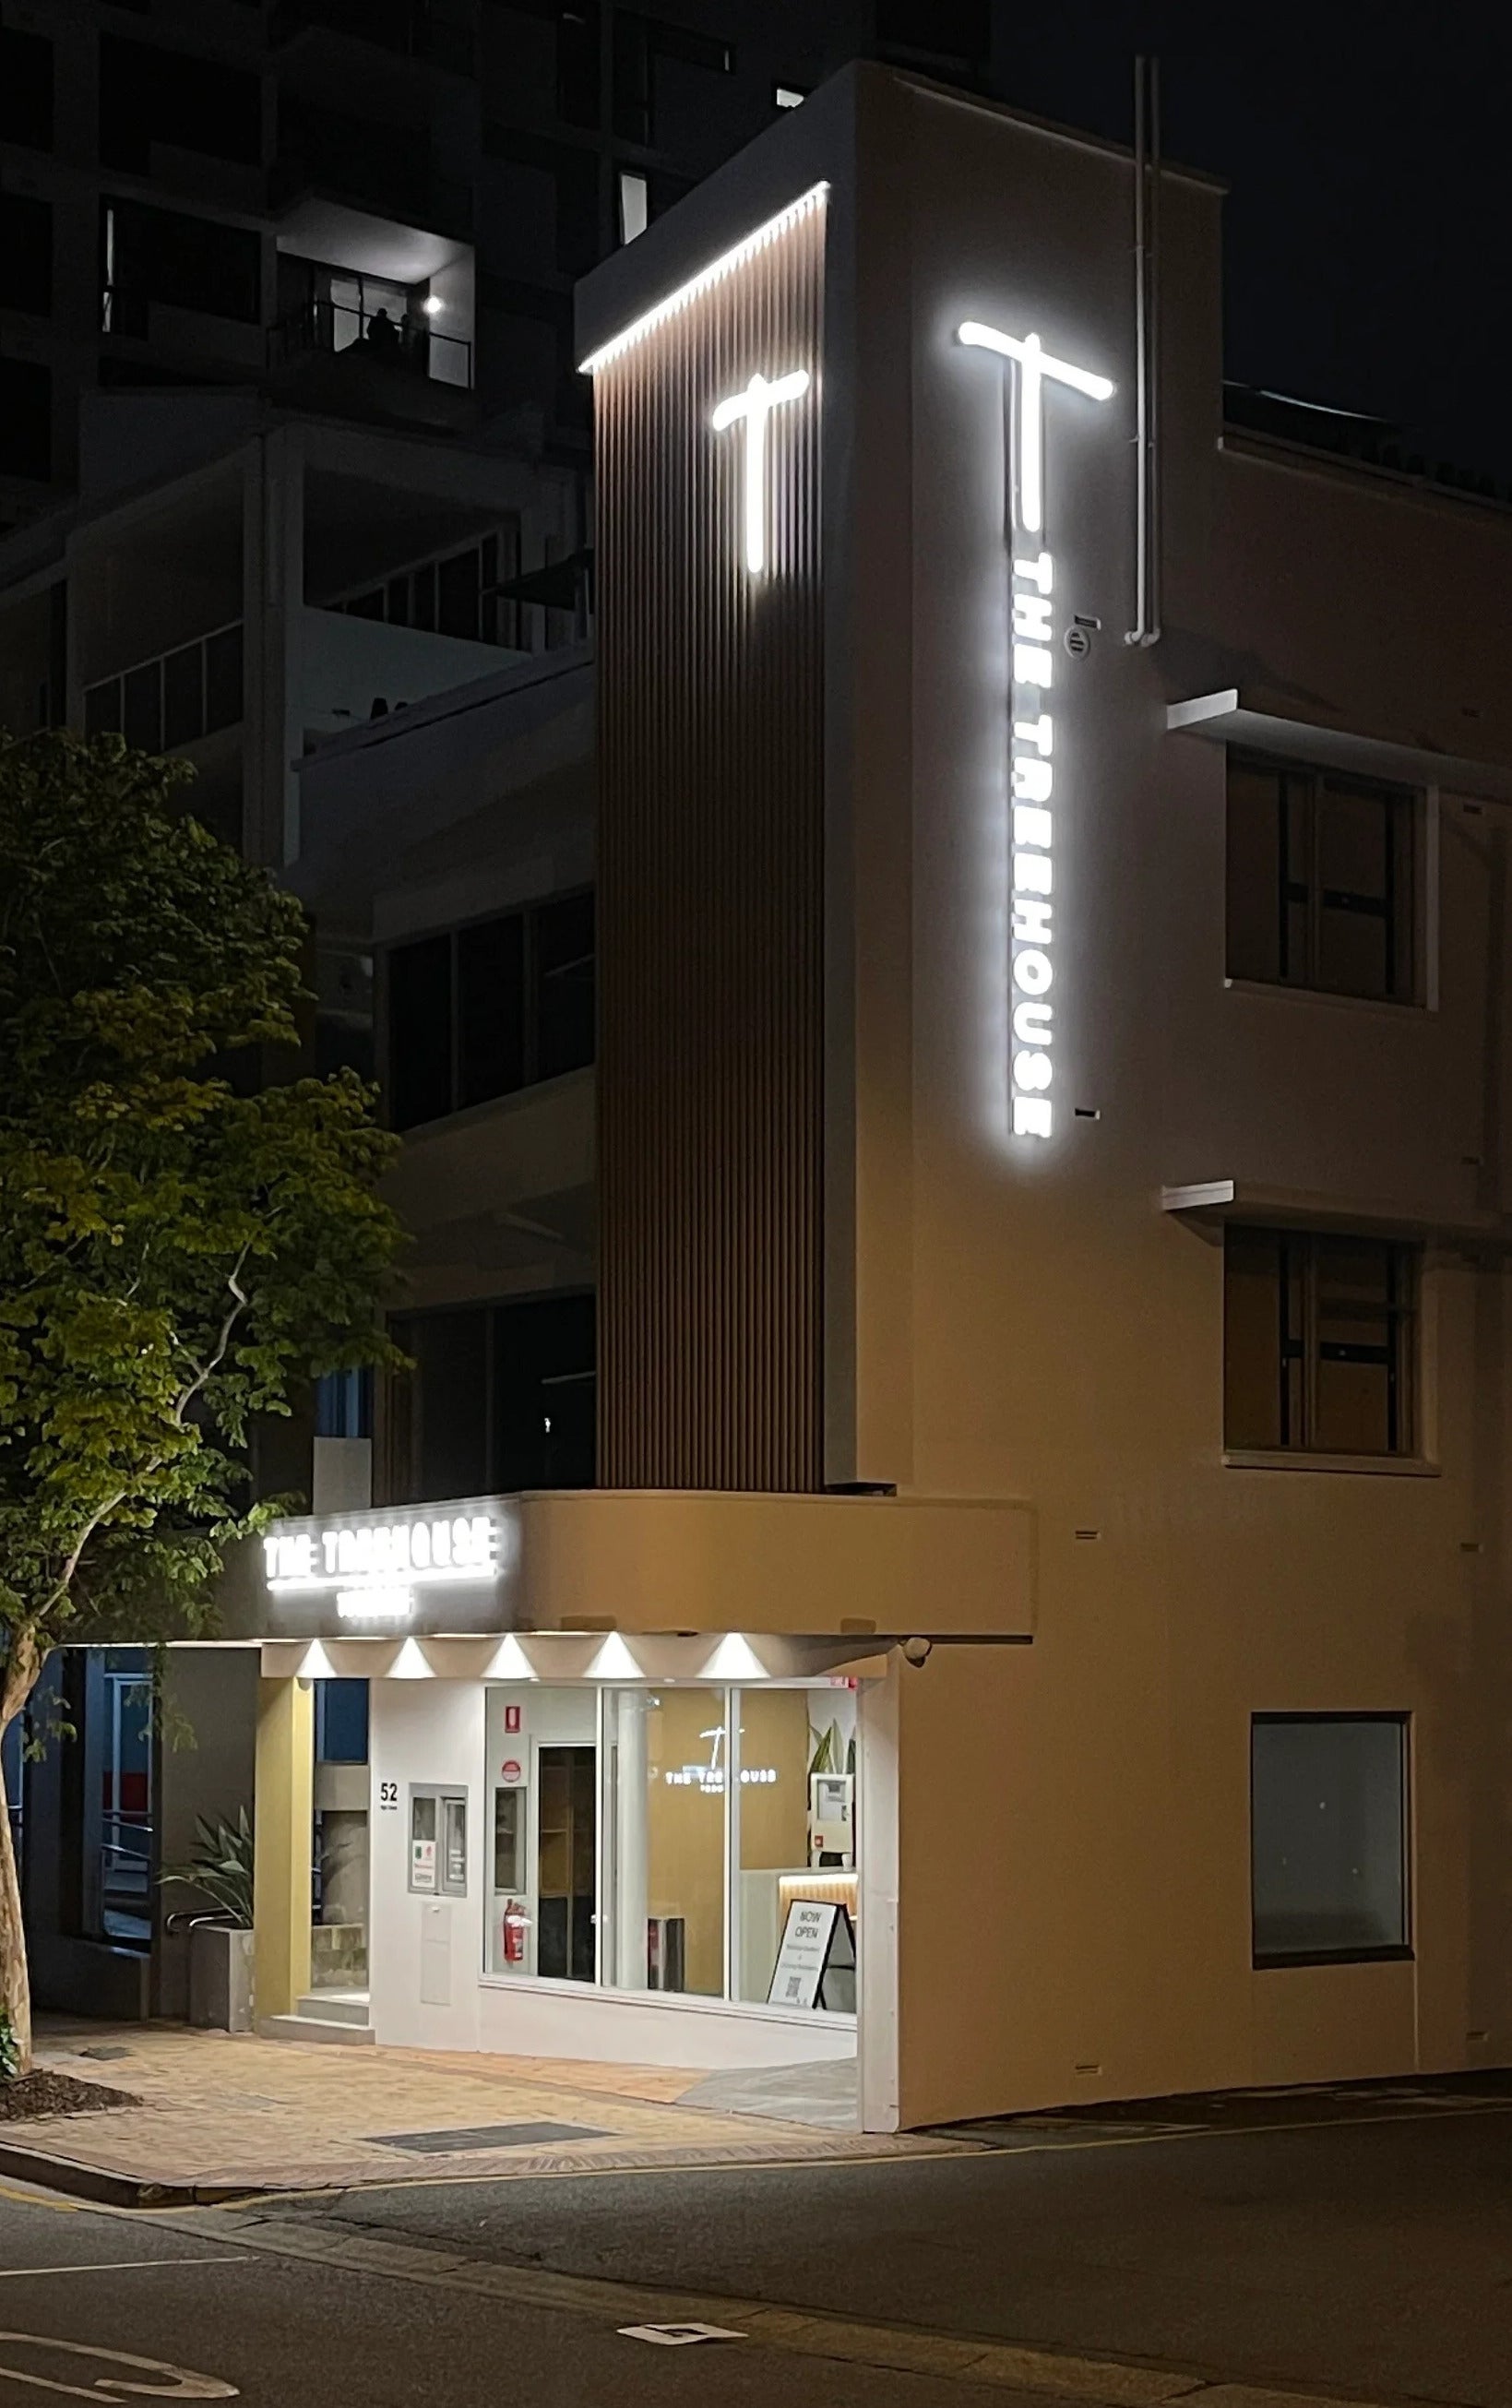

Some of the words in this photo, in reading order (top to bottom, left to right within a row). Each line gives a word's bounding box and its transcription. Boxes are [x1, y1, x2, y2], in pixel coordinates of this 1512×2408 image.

[1013, 552, 1054, 689] THE
[1013, 714, 1054, 1138] TREEHOUSE
[263, 1532, 319, 1579] THE
[380, 1782, 398, 1802] 52
[794, 1925, 819, 1938] OPEN
[799, 1910, 822, 1923] NOW
